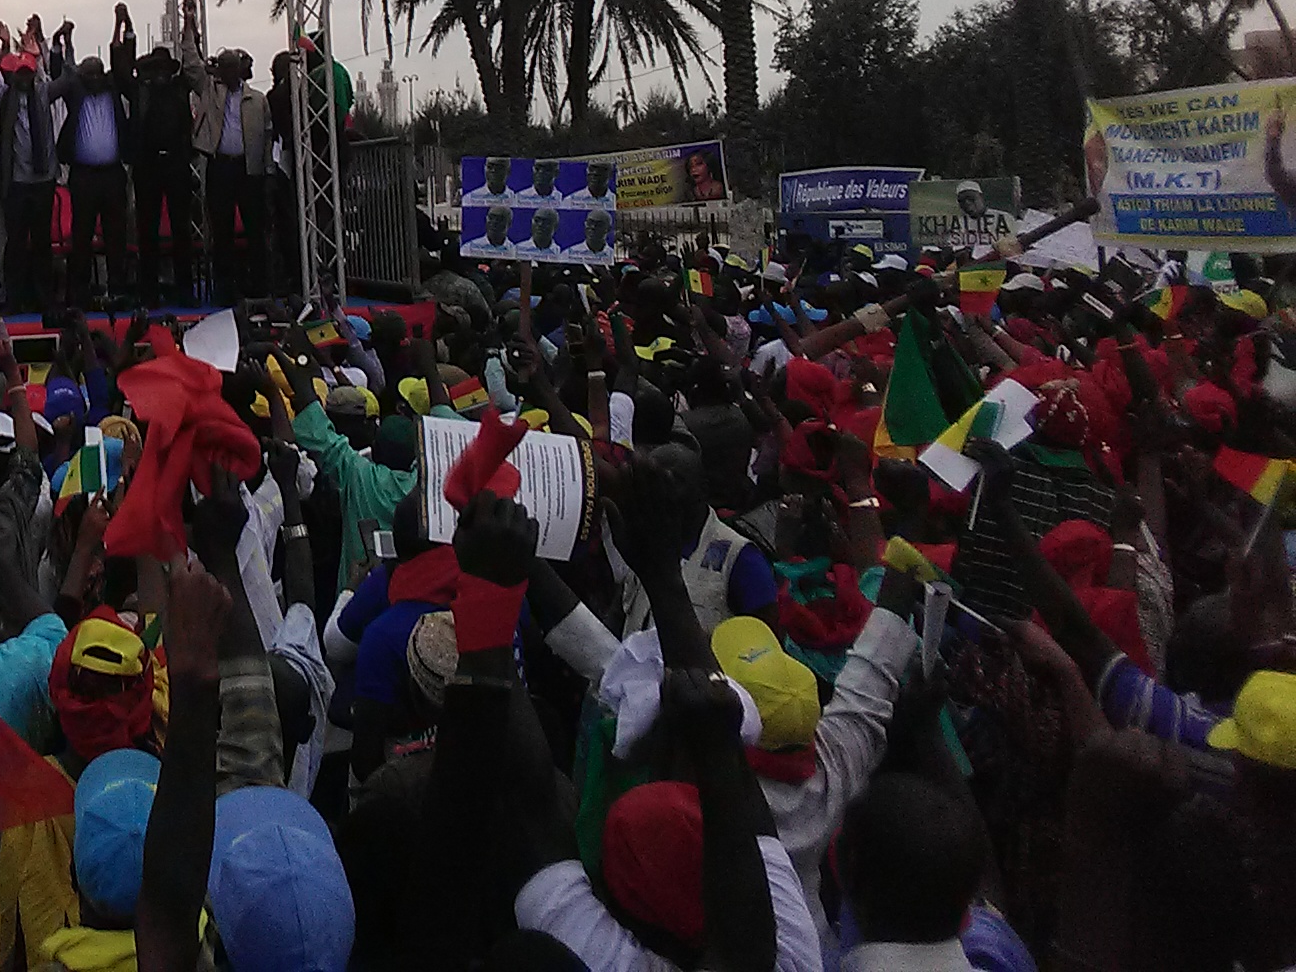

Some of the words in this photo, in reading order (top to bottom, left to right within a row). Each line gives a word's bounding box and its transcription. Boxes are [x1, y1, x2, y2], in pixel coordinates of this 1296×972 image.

[1149, 101, 1178, 115] WE
[1186, 93, 1240, 112] CAN
[1196, 111, 1260, 135] KARIM
[637, 174, 667, 186] WADE
[795, 182, 844, 208] République
[845, 179, 865, 198] des
[866, 178, 908, 199] Valeurs
[918, 214, 1011, 236] KHALIFA
